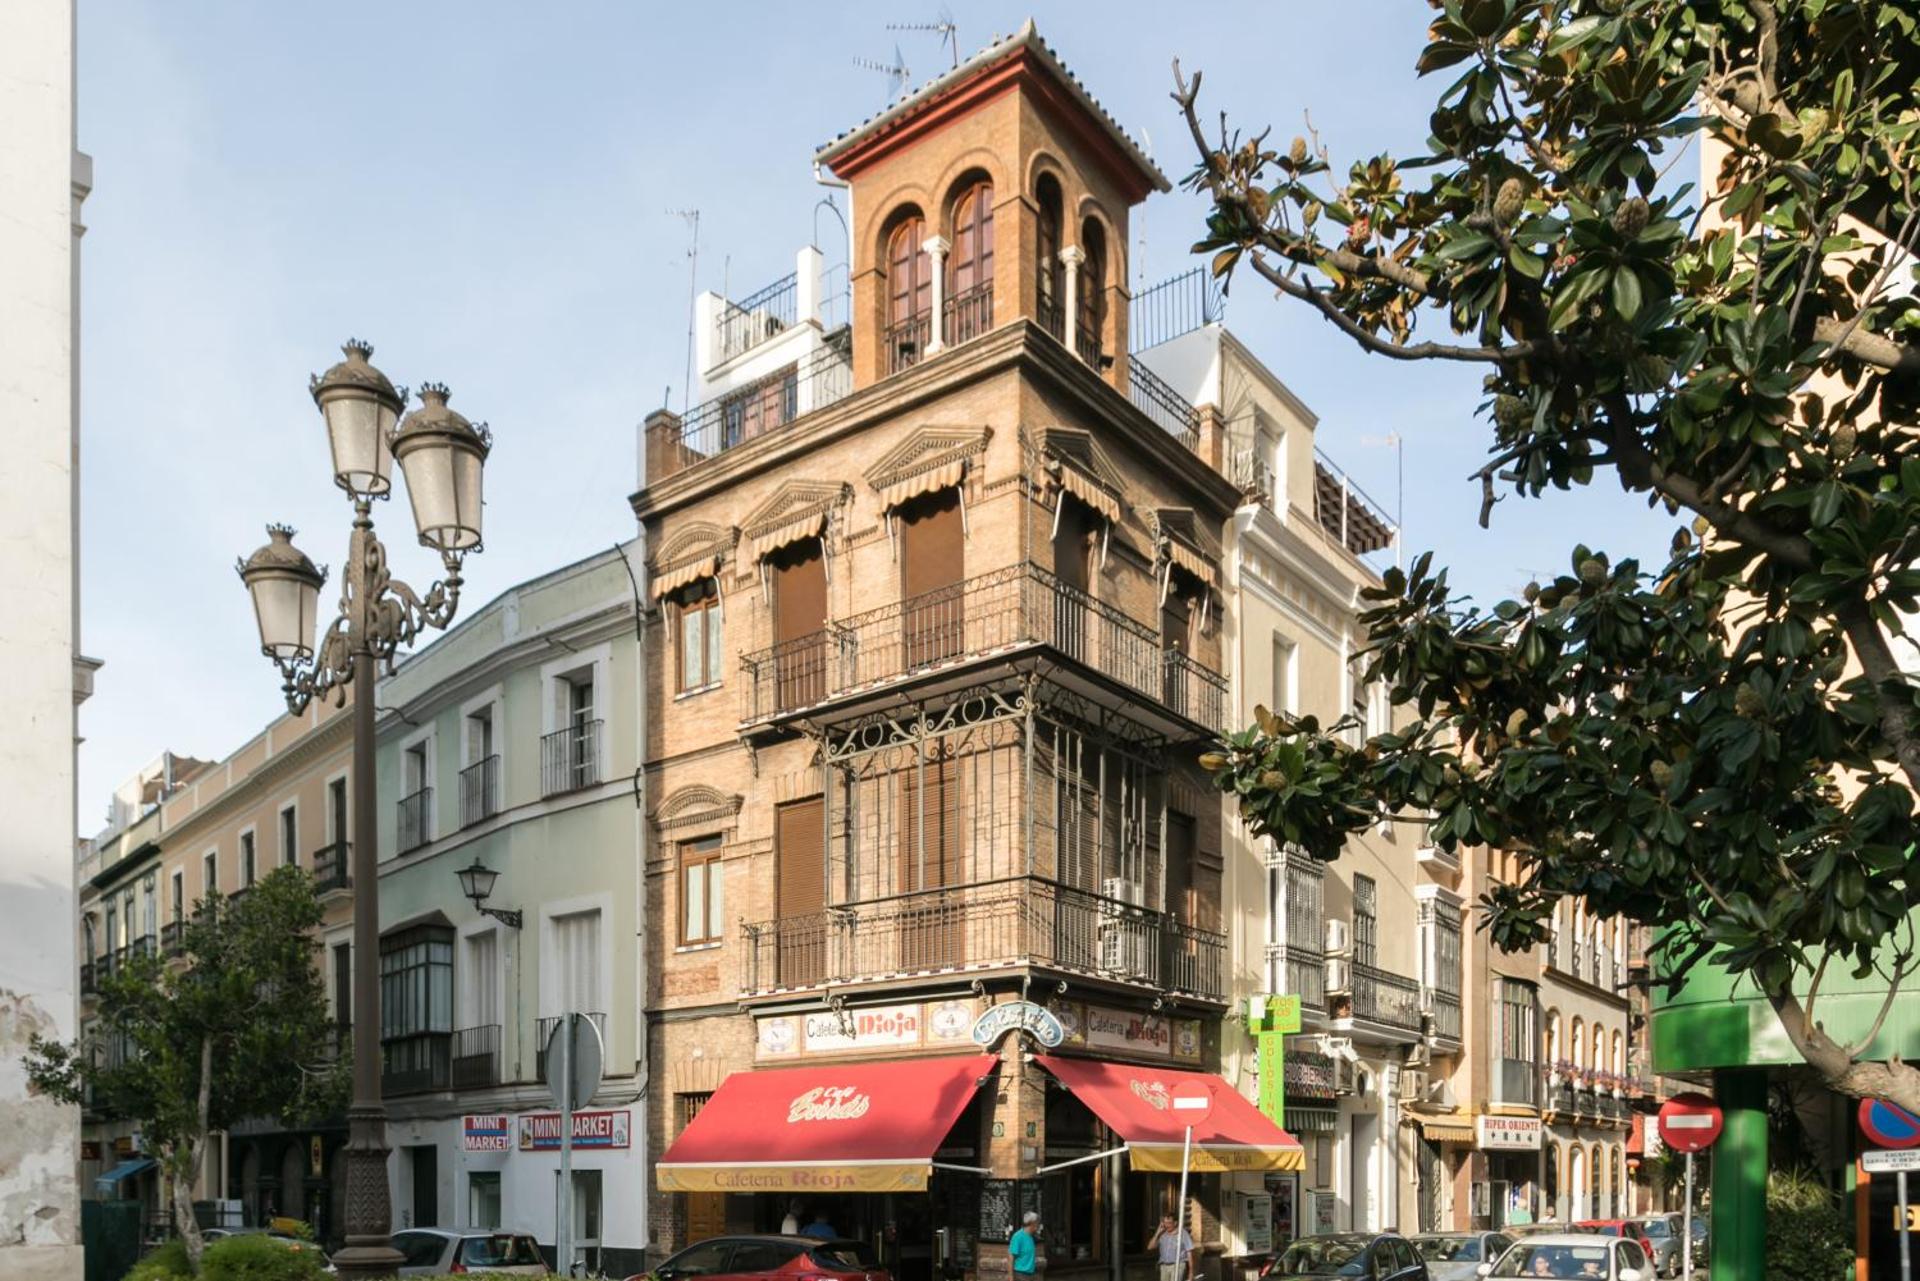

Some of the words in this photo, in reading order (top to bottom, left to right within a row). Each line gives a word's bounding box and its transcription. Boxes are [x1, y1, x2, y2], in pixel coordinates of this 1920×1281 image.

[858, 1011, 916, 1037] Rioja
[472, 1116, 500, 1130] MINI
[534, 1117, 561, 1138] MINI
[1485, 1119, 1506, 1130] HIPER
[1508, 1120, 1539, 1131] ORIENTE
[465, 1136, 508, 1150] MARKET
